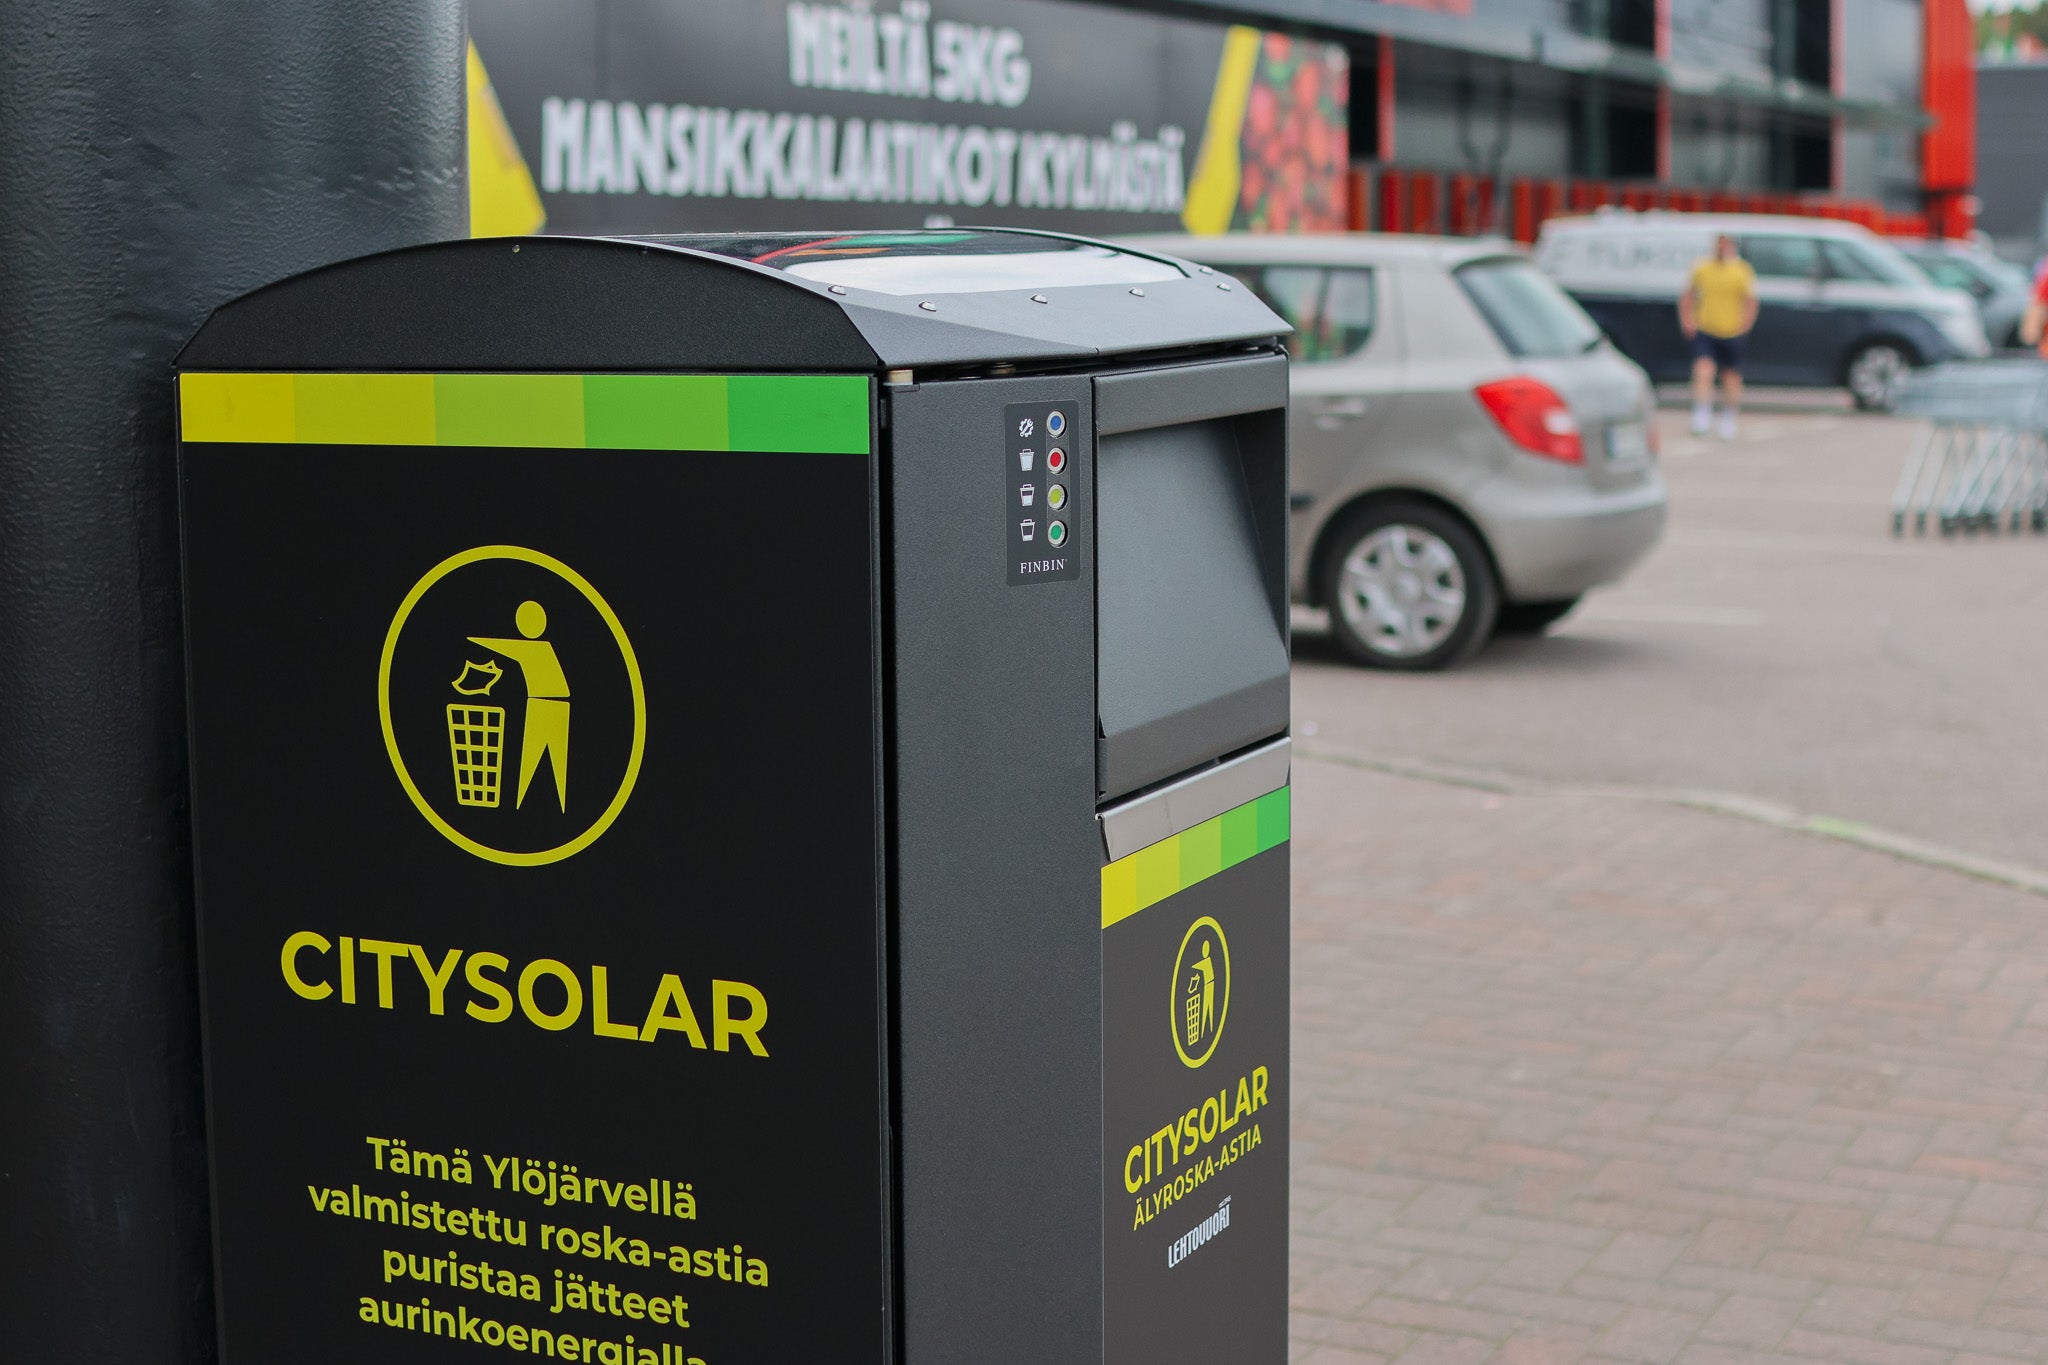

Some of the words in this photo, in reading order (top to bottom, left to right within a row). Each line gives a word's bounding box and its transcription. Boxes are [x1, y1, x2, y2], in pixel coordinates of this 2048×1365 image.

[932, 19, 1031, 108] 5KG
[542, 97, 1018, 206] MANSIKKALAATIKOT
[1019, 558, 1065, 574] FINBIN
[280, 930, 770, 1058] CITYSOLAR
[366, 1136, 473, 1185] Tämä
[483, 1154, 697, 1221] Ylöjärvellä
[1124, 1065, 1269, 1194] CITYSOLAR
[1133, 1123, 1262, 1231] ÄLYROSKA-ASTIA
[307, 1183, 527, 1247] valmistettu
[540, 1224, 770, 1288] roska-astia
[383, 1249, 541, 1302] puristaa
[549, 1268, 690, 1328] jätteet
